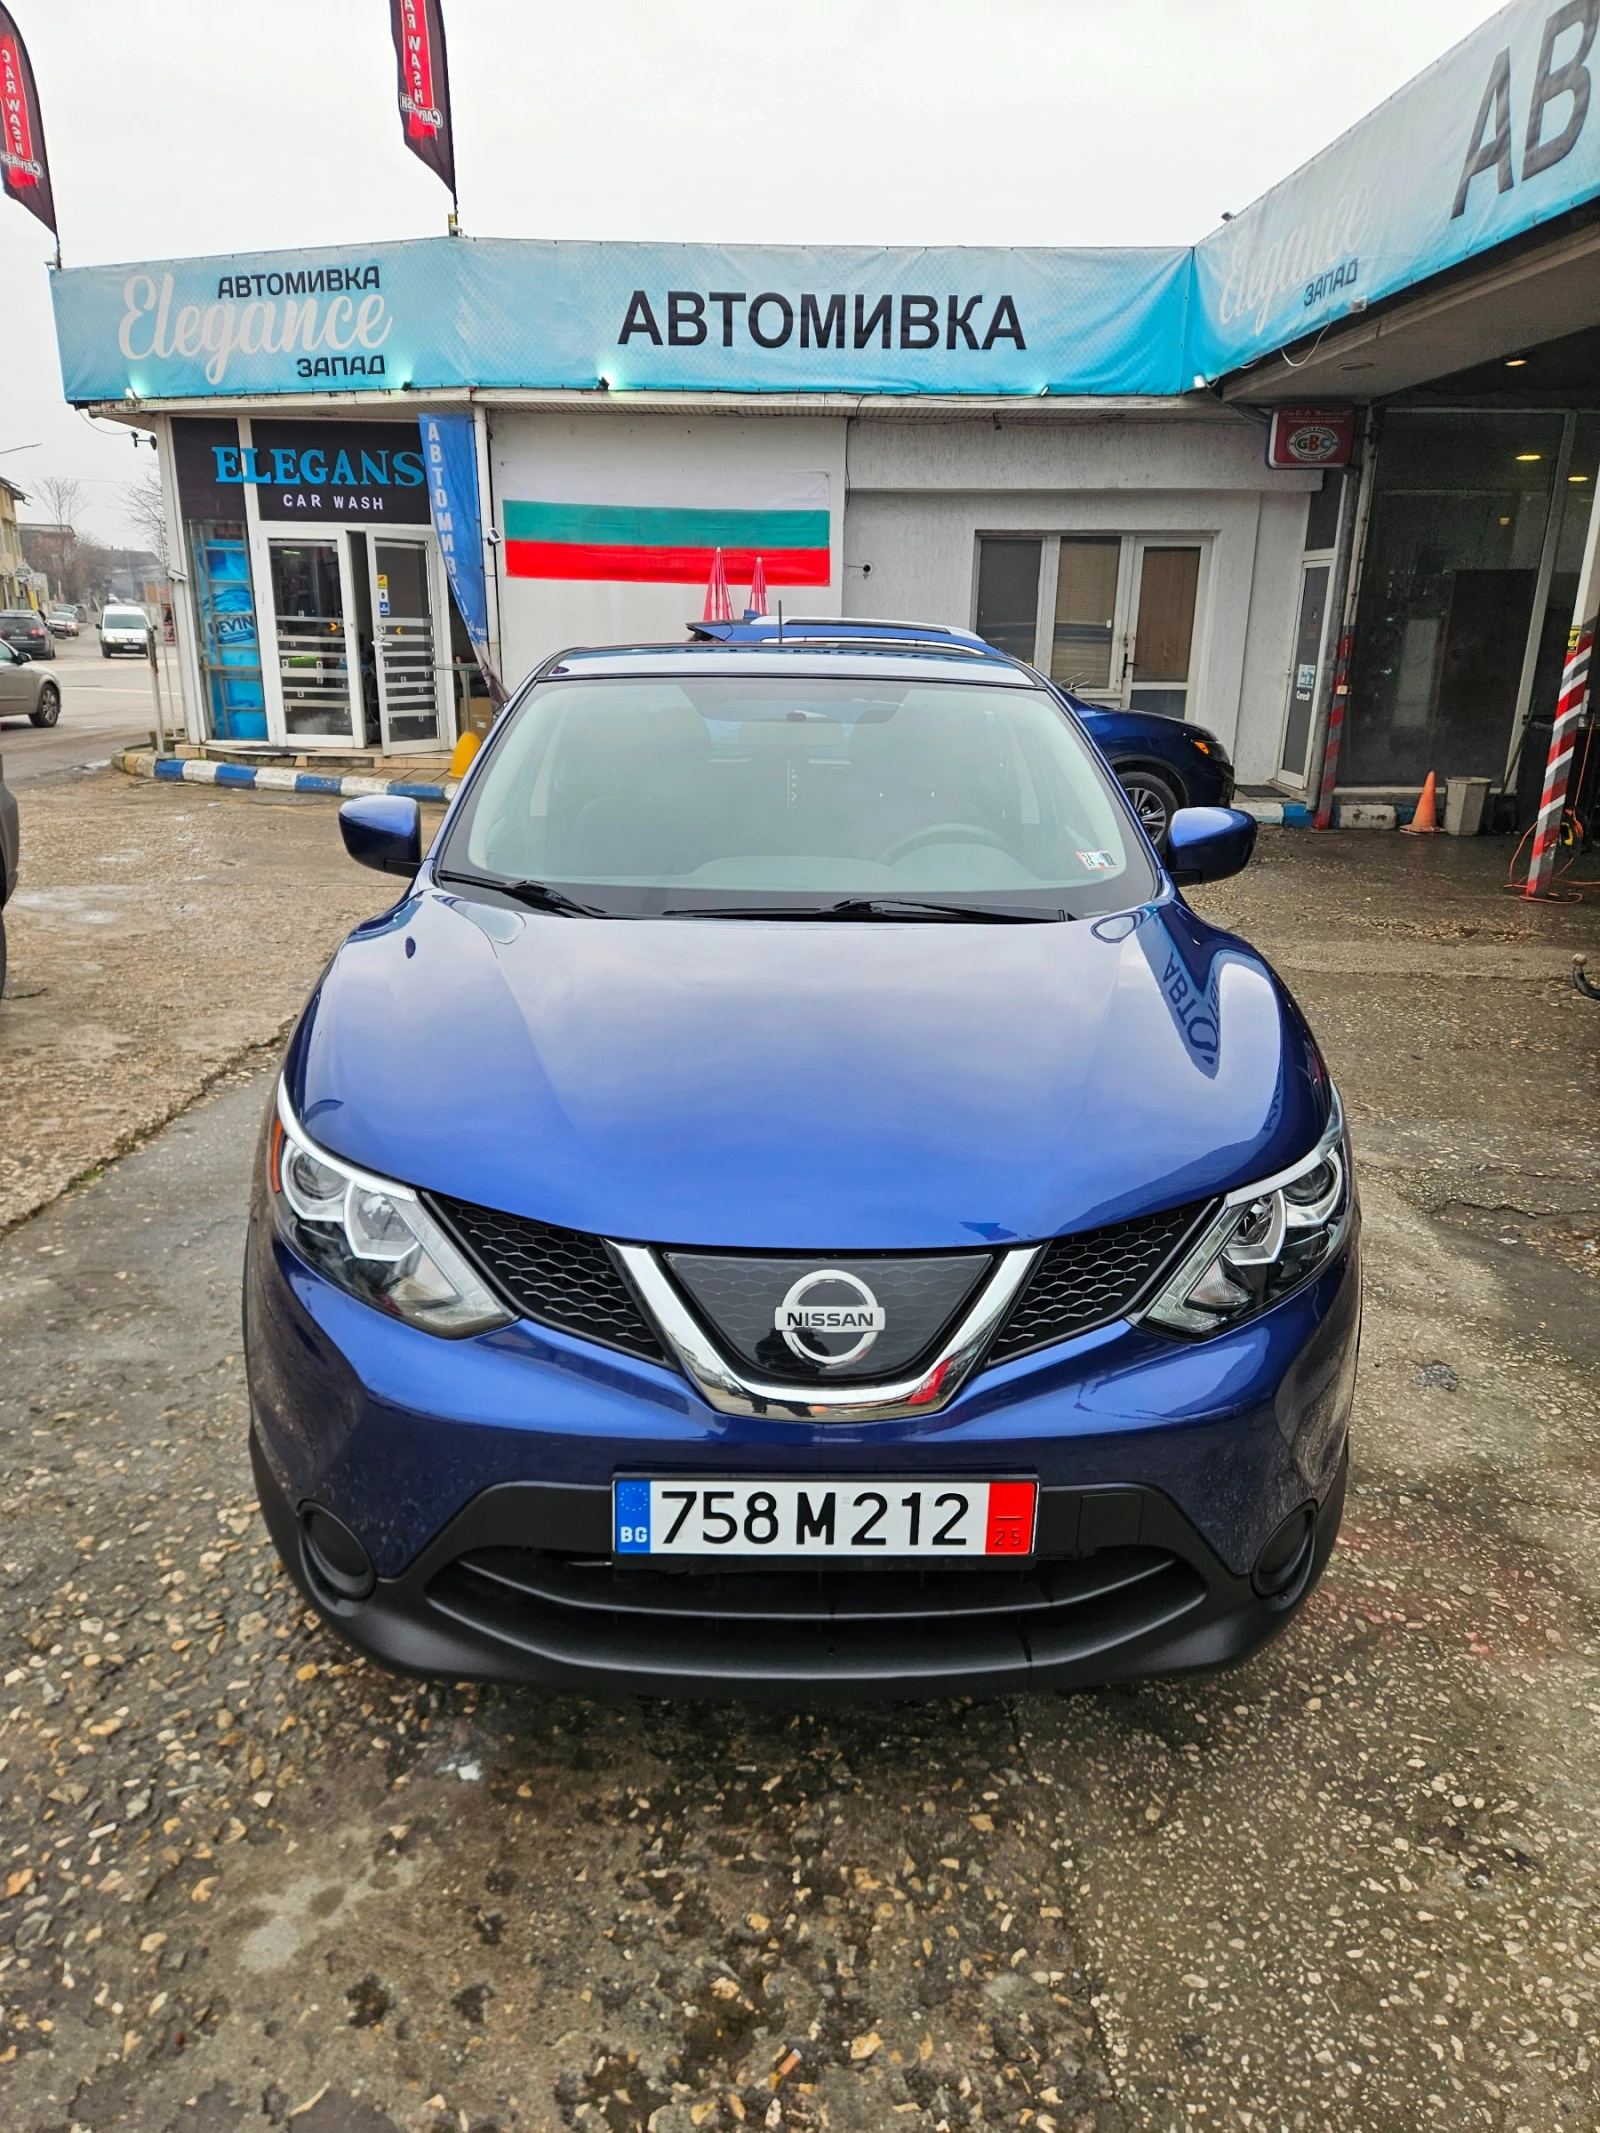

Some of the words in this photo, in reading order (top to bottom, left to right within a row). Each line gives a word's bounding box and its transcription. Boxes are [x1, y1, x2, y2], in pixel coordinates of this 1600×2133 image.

[218, 266, 380, 299] АВТОМИВКА
[1303, 258, 1359, 308] ЗАПАД
[118, 273, 393, 385] Elegance
[617, 290, 1027, 350] АВТОМИВКА
[297, 355, 386, 377] ЗАПАД
[1297, 434, 1331, 452] GBC
[211, 446, 426, 487] ELEGANS
[283, 494, 322, 508] CAR
[333, 495, 383, 511] WASH
[787, 1312, 874, 1327] NISSAN
[620, 1527, 648, 1543] BG
[994, 1528, 1021, 1546] 25
